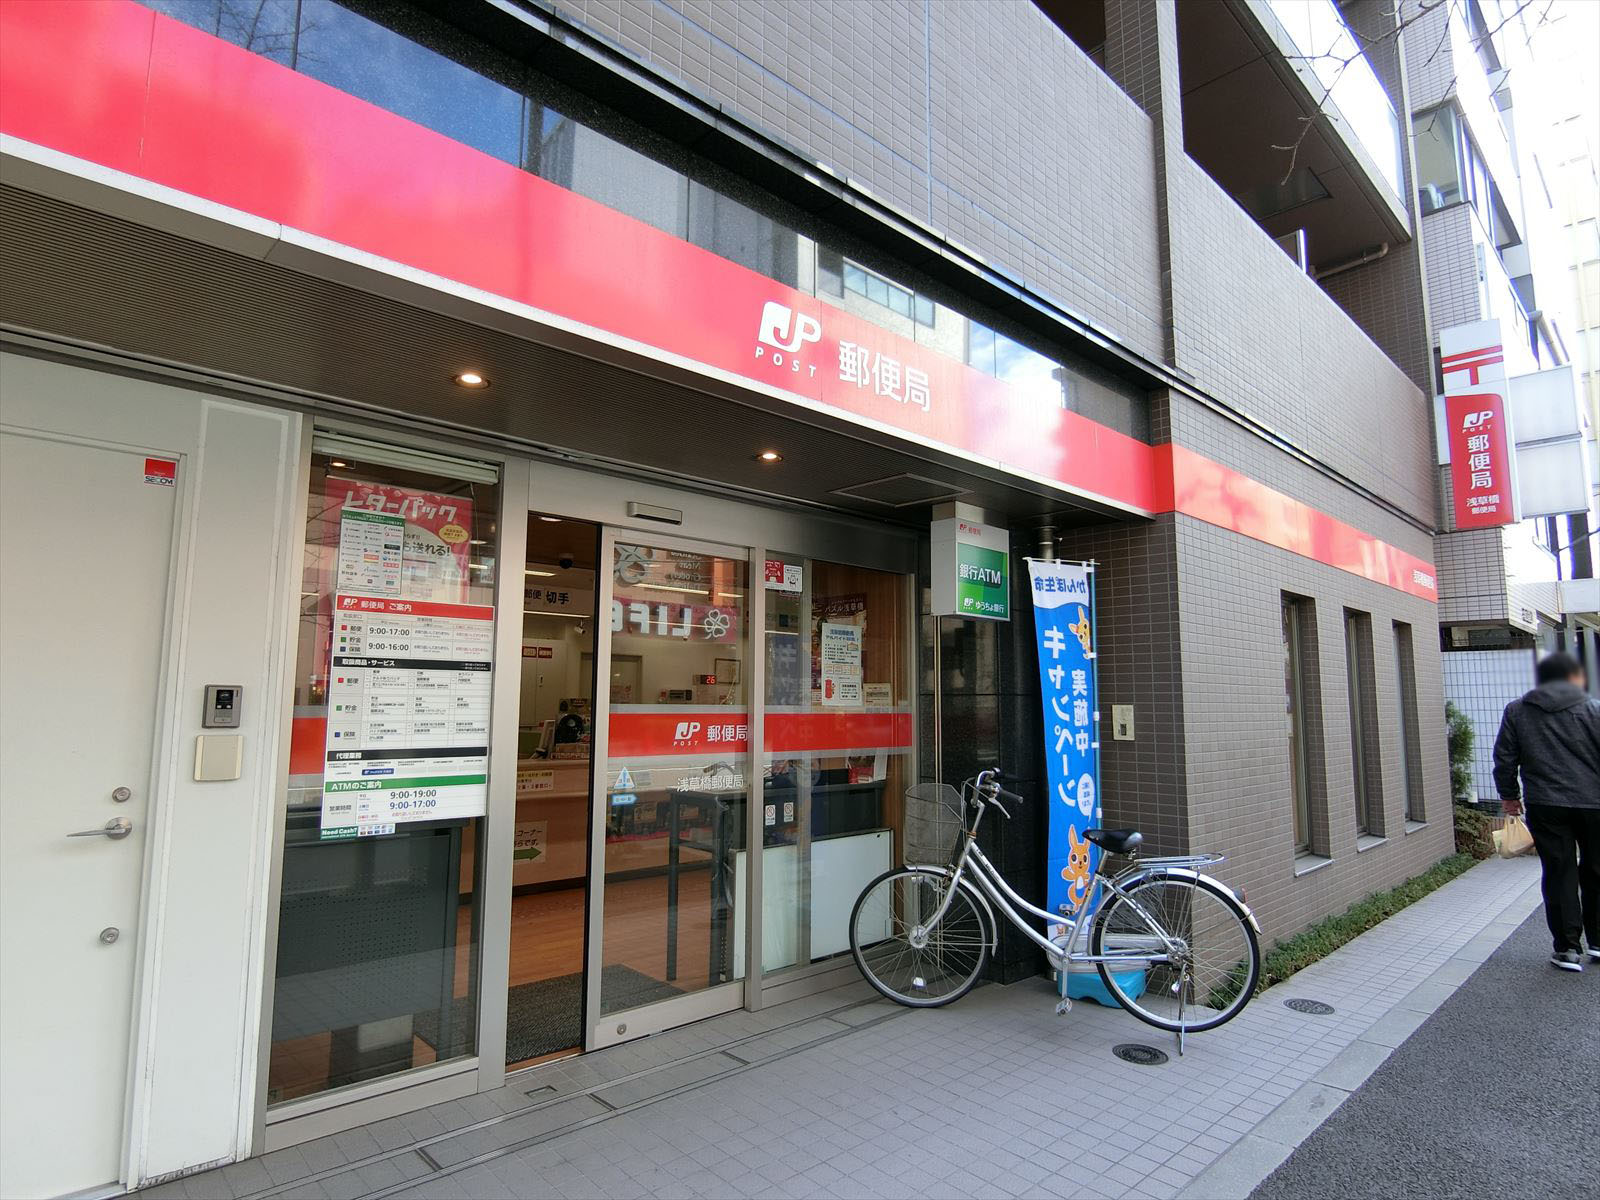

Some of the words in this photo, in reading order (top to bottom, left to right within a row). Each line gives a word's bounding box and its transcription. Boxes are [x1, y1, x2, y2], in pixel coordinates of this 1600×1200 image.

[754, 346, 817, 378] POST
[838, 339, 931, 412] 郵便局
[1462, 424, 1492, 434] POST
[1467, 433, 1492, 490] 郵便局
[145, 475, 173, 485] SECOM
[345, 490, 457, 521] レターパック
[959, 563, 1001, 585] 銀行ATM
[546, 591, 569, 605] 切手
[369, 626, 410, 636] 9:00-17:00
[368, 642, 409, 651] 9:00-16:00
[706, 676, 716, 684] 26
[706, 725, 748, 742] 郵便局
[331, 781, 382, 791] ATMのご案内
[676, 774, 744, 792] 浅草橋郵便局
[390, 789, 437, 799] 9:00-19:00
[389, 799, 437, 810] 9:00-17:00
